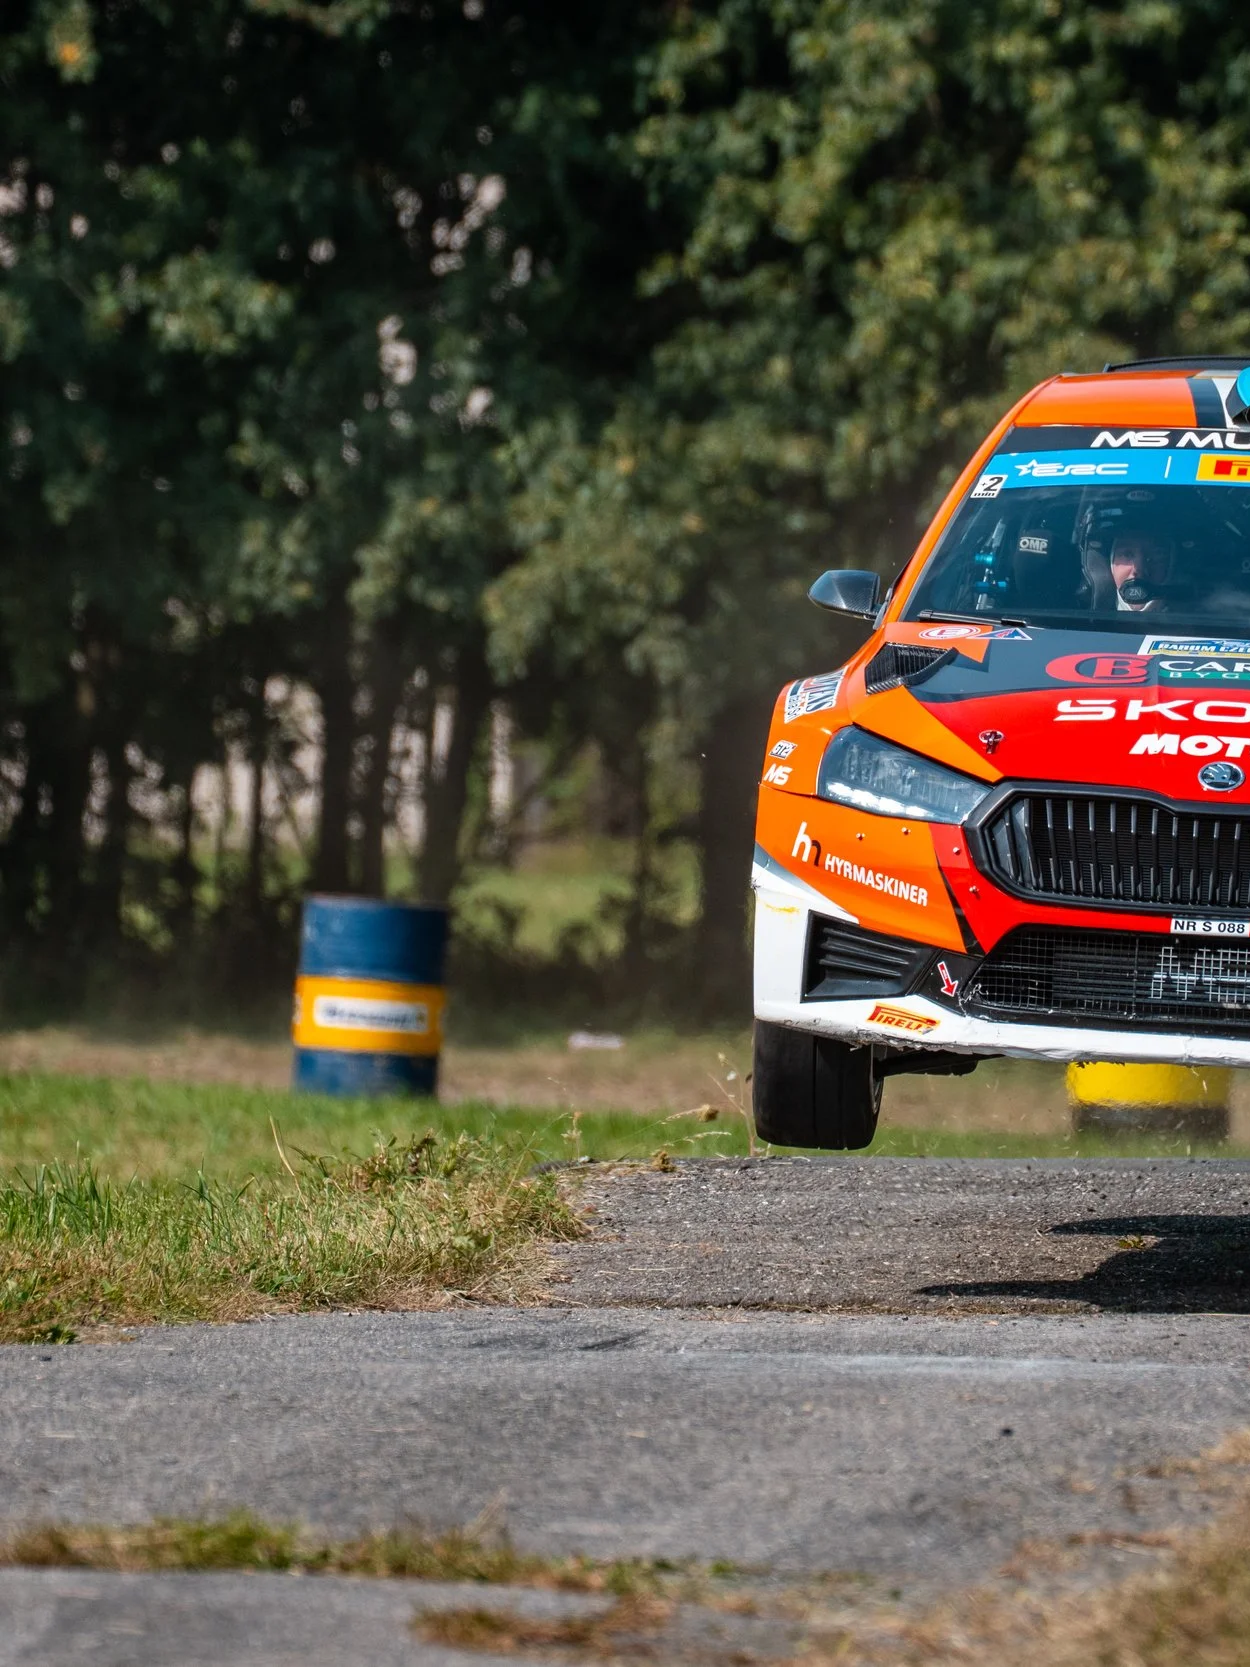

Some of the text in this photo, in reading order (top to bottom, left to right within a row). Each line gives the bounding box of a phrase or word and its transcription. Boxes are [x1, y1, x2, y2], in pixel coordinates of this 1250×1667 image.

[1090, 431, 1171, 448] MS
[1019, 537, 1048, 553] OMP
[763, 763, 793, 785] MS
[824, 853, 928, 907] HYRMASKINER
[1174, 920, 1245, 934] NR S 088
